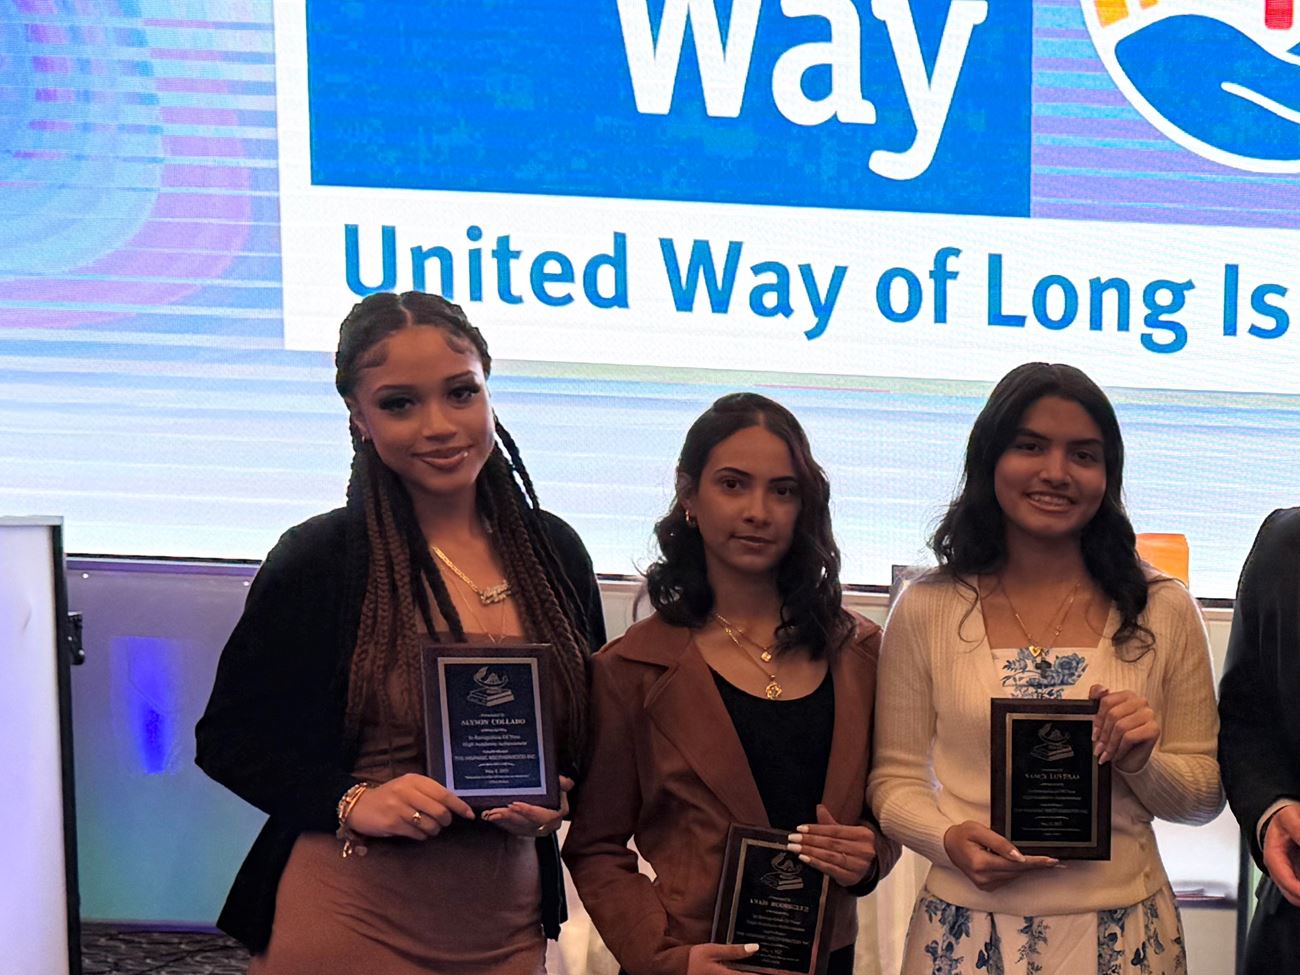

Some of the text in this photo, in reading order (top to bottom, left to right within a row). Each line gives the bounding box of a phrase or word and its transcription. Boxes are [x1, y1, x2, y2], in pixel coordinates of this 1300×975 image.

[613, 0, 988, 181] Way
[343, 223, 629, 310] United
[657, 236, 849, 342] Way
[874, 246, 962, 325] of
[986, 252, 1196, 355] Long
